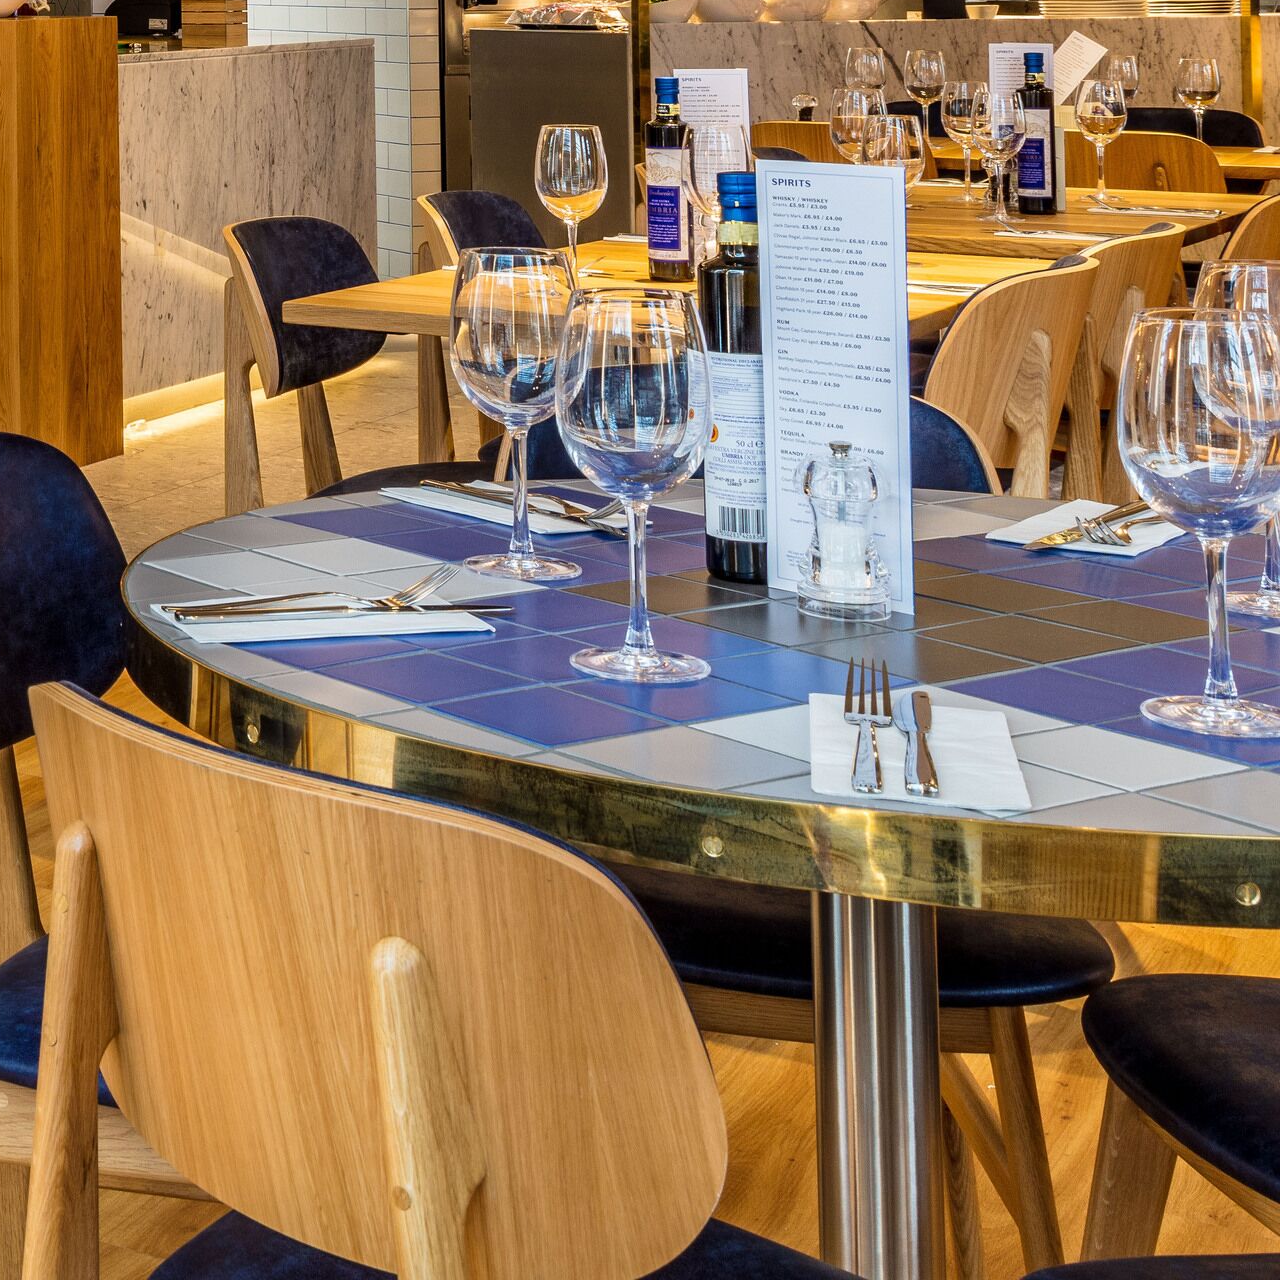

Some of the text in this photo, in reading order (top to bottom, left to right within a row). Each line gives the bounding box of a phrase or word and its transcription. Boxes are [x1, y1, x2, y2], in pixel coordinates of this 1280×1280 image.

[771, 177, 811, 187] SPIRITS
[647, 206, 678, 214] MBRIA
[780, 429, 804, 437] TEQUILA
[747, 440, 754, 448] cl
[721, 452, 744, 460] UMBRIA
[780, 449, 803, 457] BRANDY
